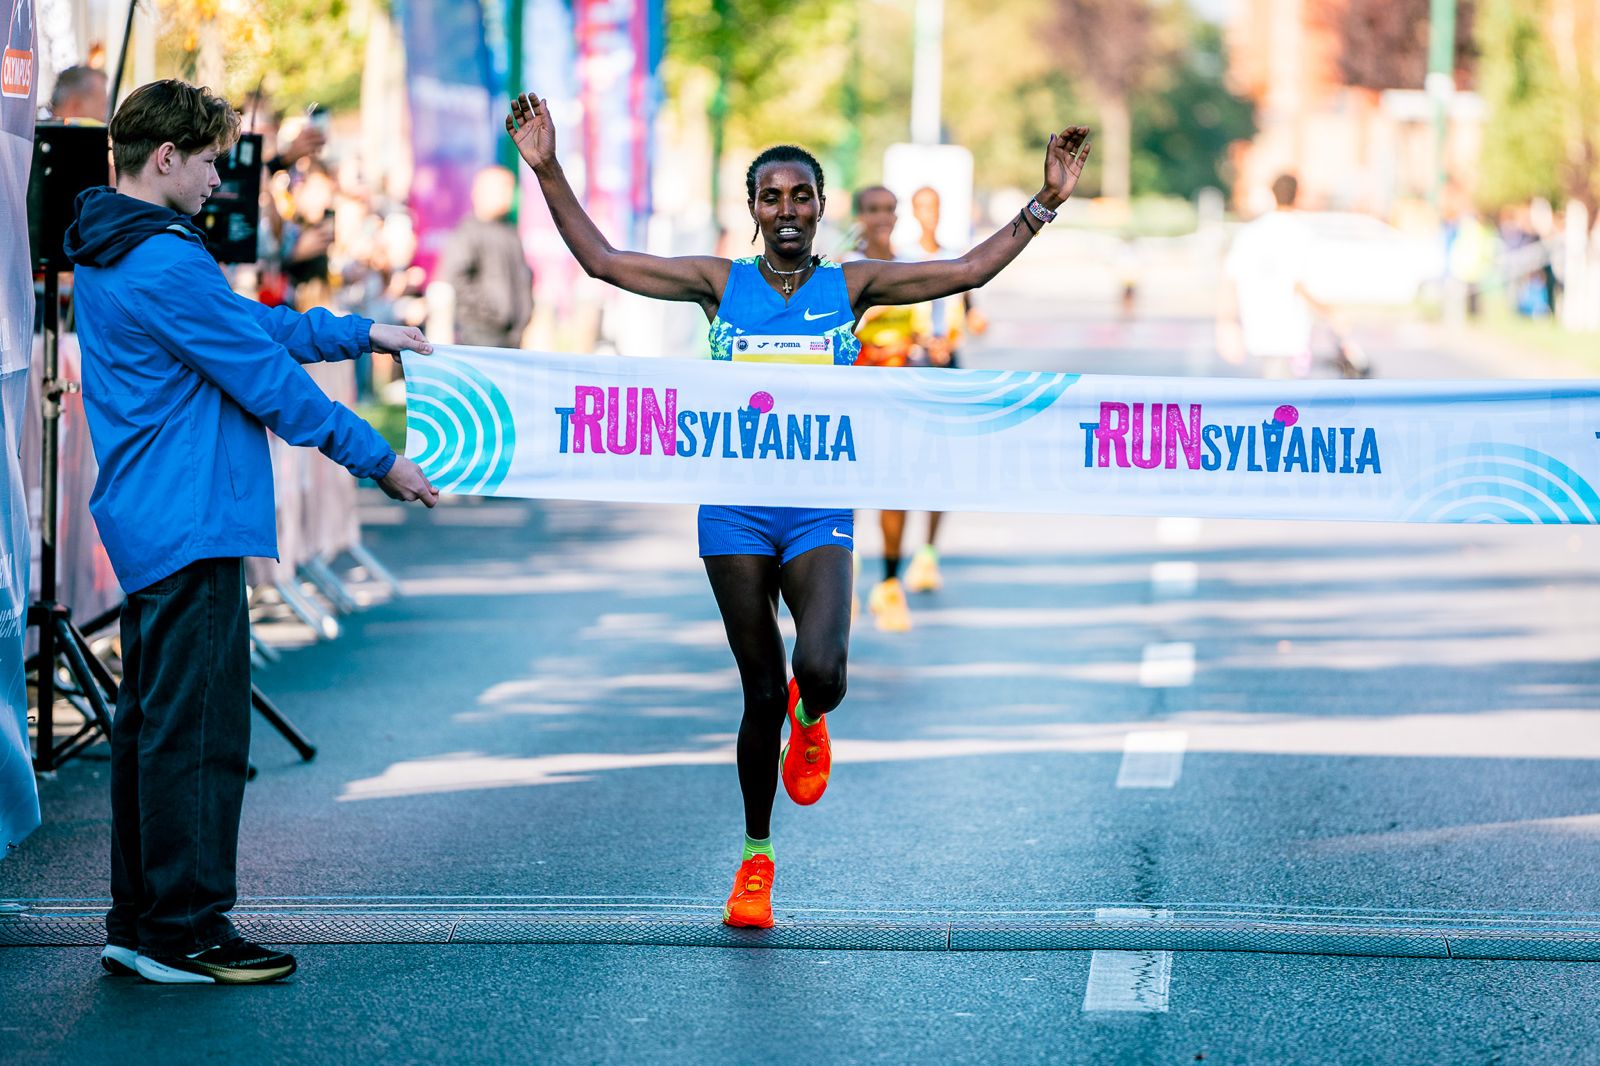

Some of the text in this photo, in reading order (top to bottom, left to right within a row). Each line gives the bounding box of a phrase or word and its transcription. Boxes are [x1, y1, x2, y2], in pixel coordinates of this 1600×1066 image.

[4, 56, 31, 86] OLYMPUS
[554, 385, 857, 462] TRUNSYLVANIA
[1079, 401, 1382, 474] TRUNSYLVANIA
